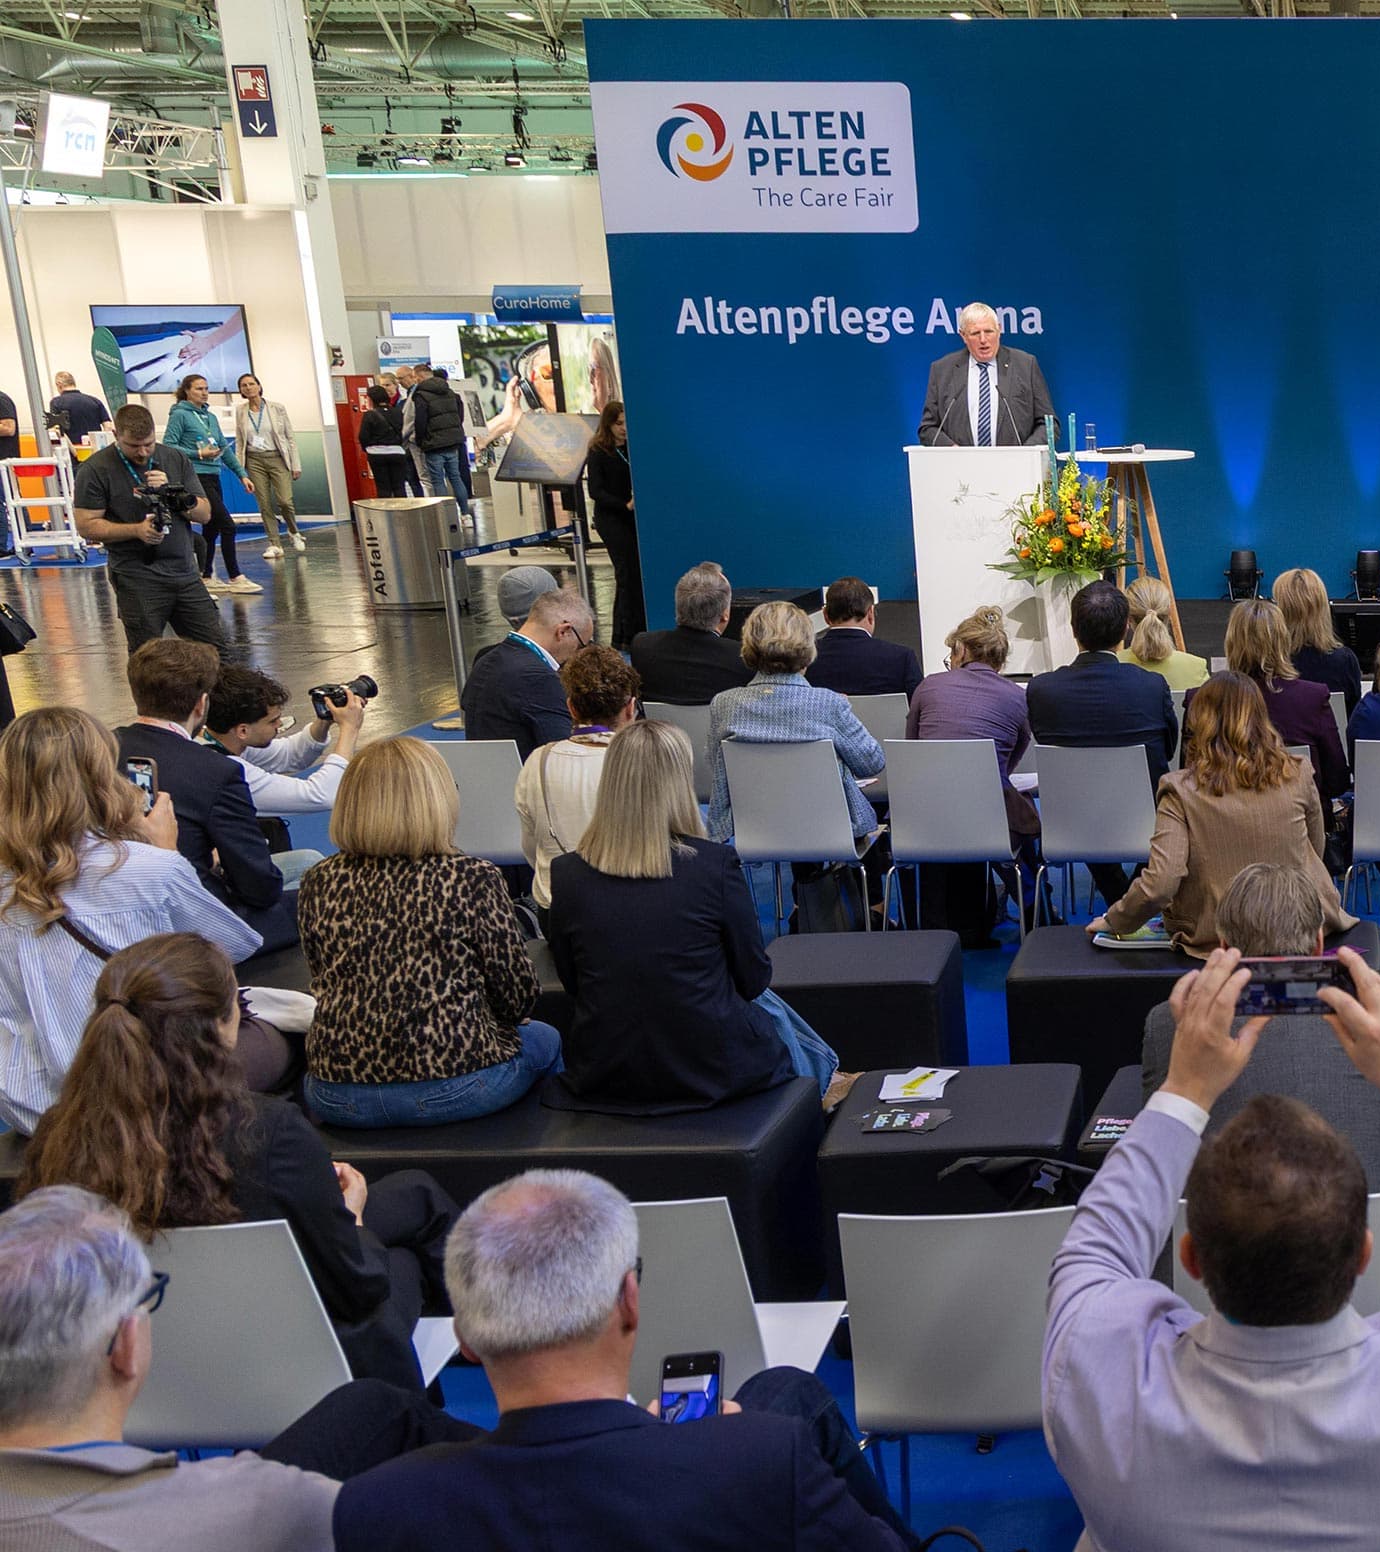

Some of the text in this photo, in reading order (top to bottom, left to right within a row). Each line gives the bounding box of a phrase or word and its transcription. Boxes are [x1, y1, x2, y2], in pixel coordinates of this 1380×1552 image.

[744, 111, 865, 139] ALTEN
[748, 148, 891, 176] PFLEGE
[752, 187, 894, 207] The Care Fair
[493, 295, 571, 309] CuraHome
[676, 297, 1044, 344] Altenpflege Ana
[366, 537, 388, 596] Abfall
